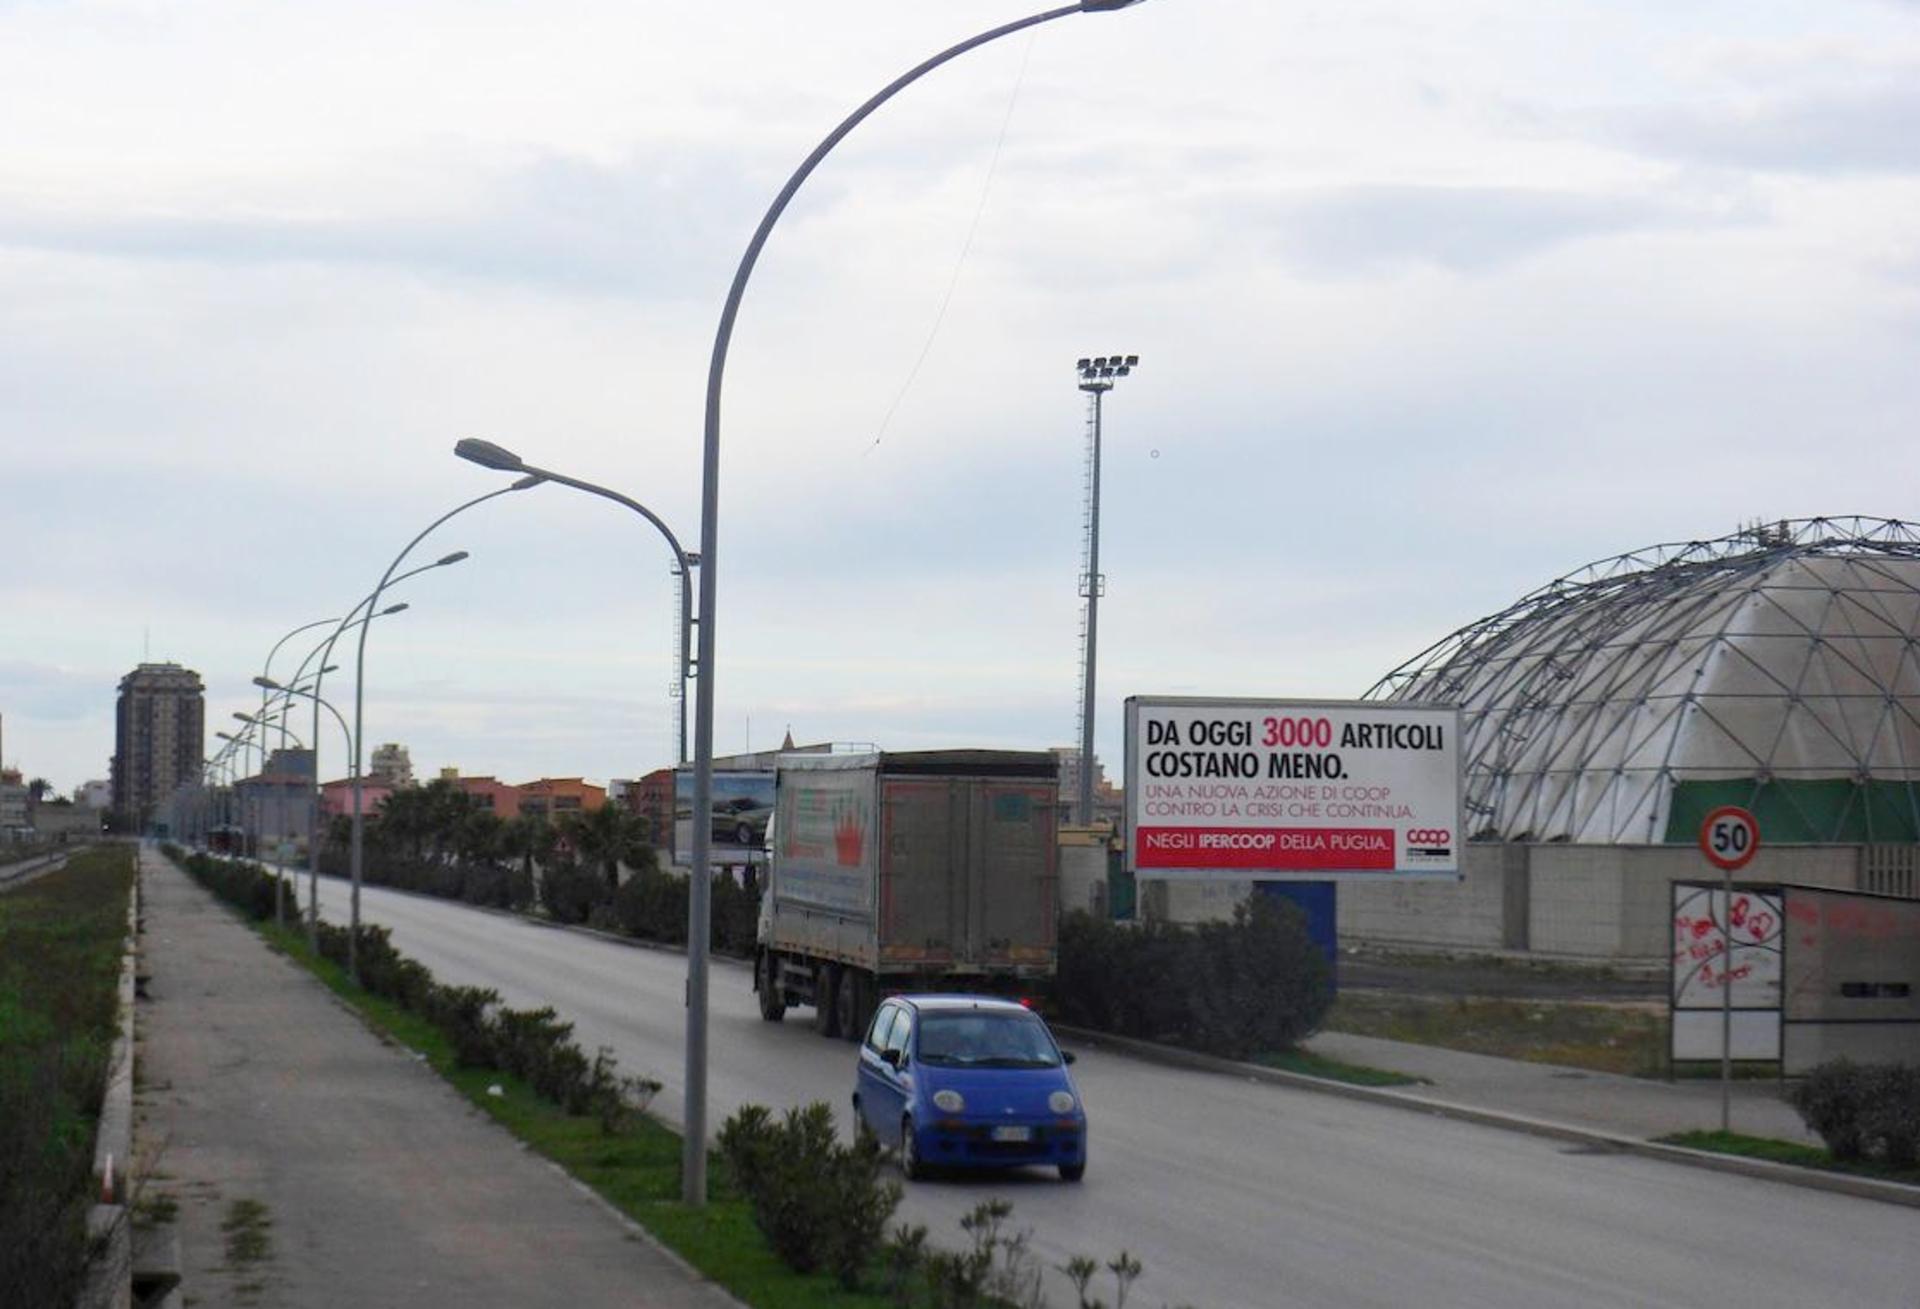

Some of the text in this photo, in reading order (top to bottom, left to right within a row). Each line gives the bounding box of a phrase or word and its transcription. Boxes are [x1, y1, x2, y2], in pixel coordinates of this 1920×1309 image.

[1147, 716, 1443, 750] DA OGGI 3000 ARTICOLI
[1146, 751, 1349, 780] COSTANO MENO.
[1145, 784, 1391, 801] UNA NUOVA AZIONE DI COOP
[1145, 801, 1417, 820] CONTRO LA CRISI CHE CONTINUA.
[1146, 832, 1390, 850] NEGLI IPERCOOP DELLA PUGLIA.
[1714, 823, 1748, 852] 50
